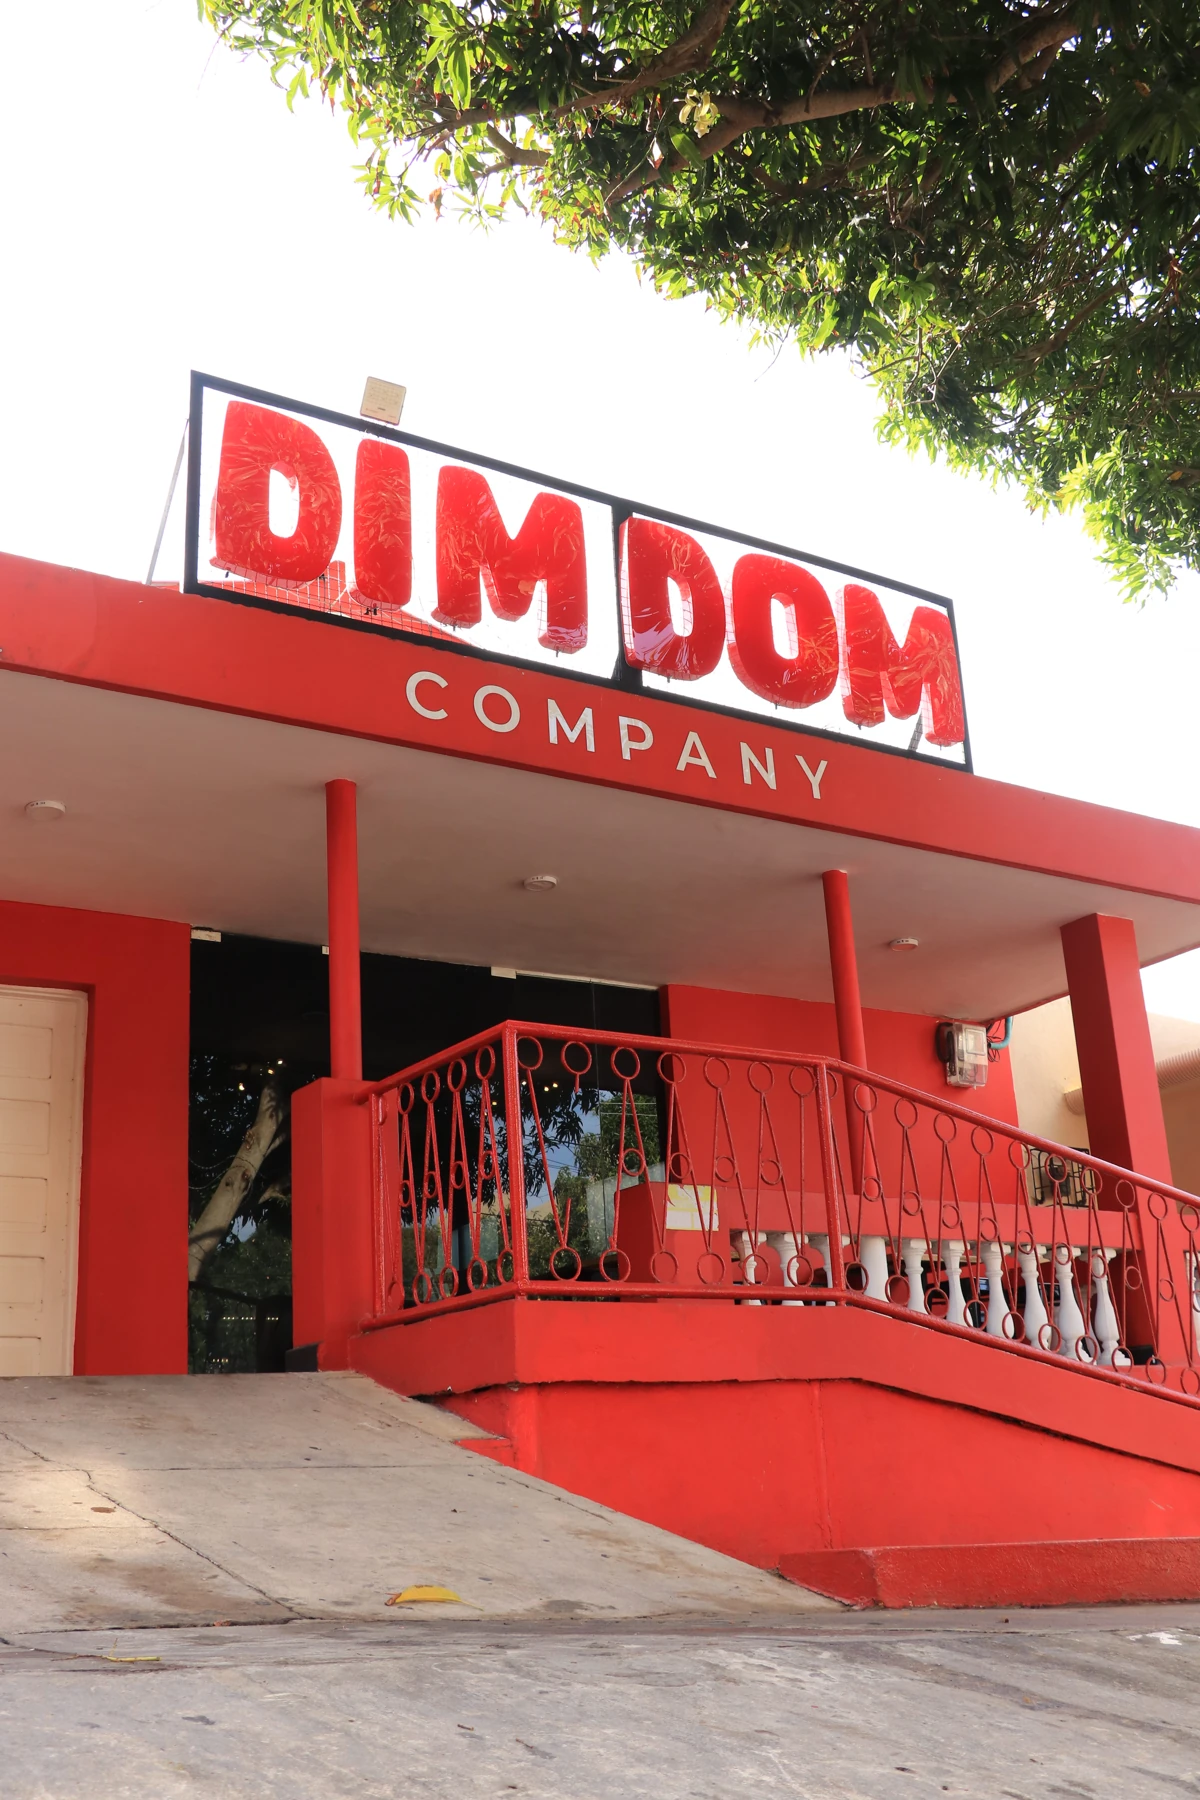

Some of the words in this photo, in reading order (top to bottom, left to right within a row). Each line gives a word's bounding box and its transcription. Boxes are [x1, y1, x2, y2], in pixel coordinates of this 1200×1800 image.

[210, 400, 588, 654] DIM
[619, 516, 965, 747] DOM
[405, 671, 828, 800] COMPANY
